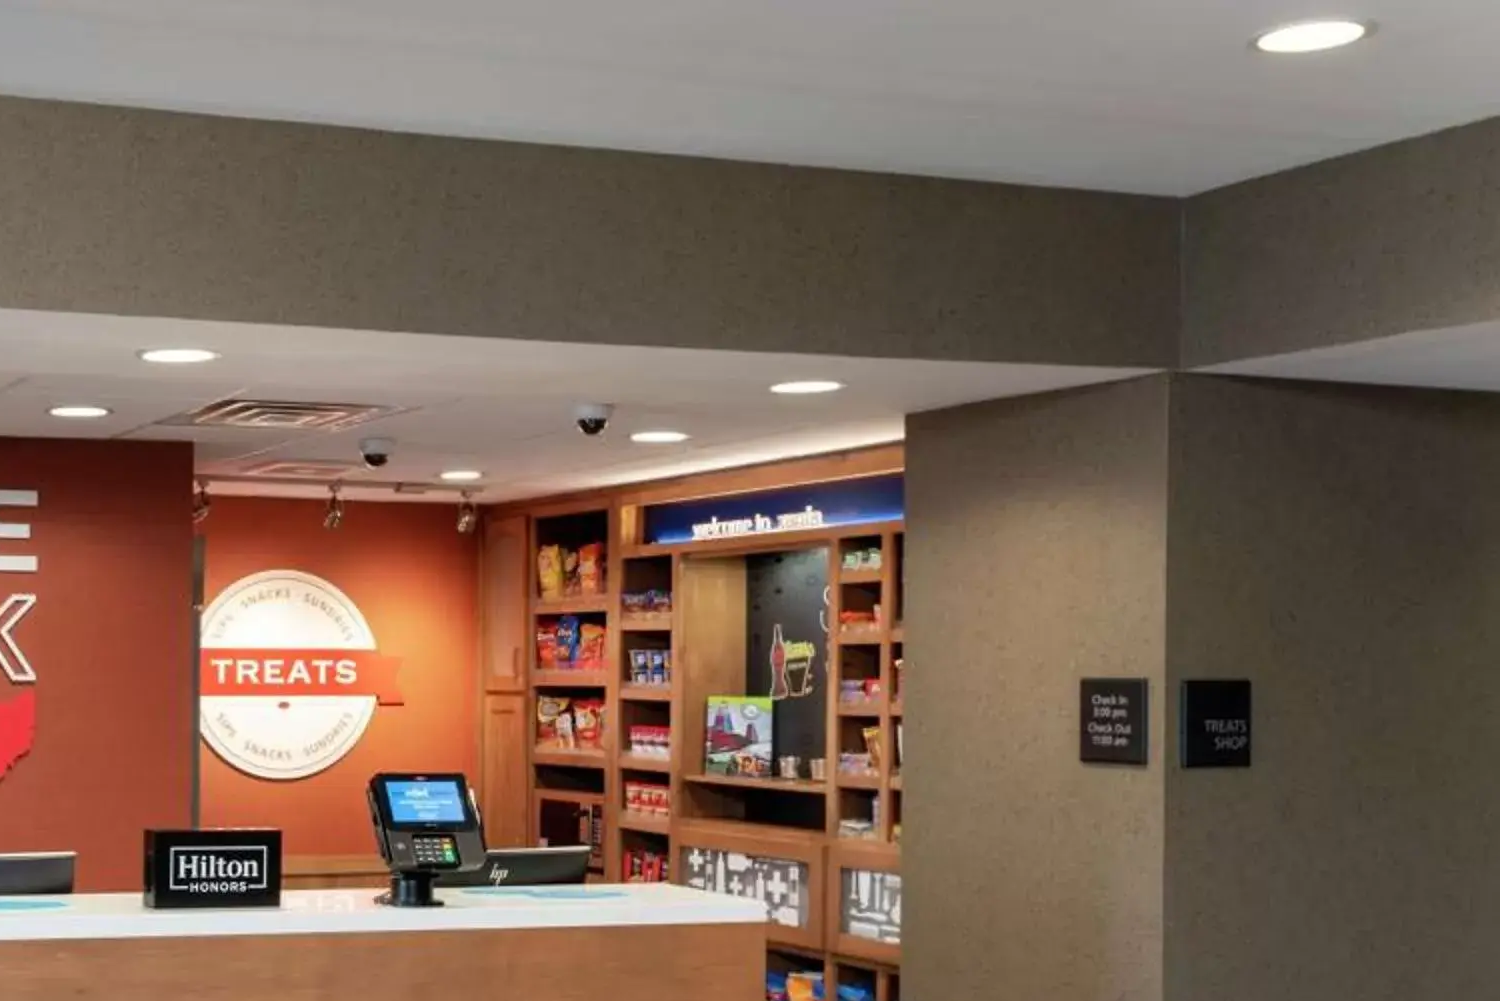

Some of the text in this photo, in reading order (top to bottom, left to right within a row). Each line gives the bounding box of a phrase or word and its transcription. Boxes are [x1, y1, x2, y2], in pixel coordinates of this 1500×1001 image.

[211, 658, 357, 685] TREATS
[1204, 719, 1247, 733] TREATS
[1214, 735, 1248, 751] SHOP
[178, 855, 259, 879] Hilton
[189, 881, 247, 893] HONORS
